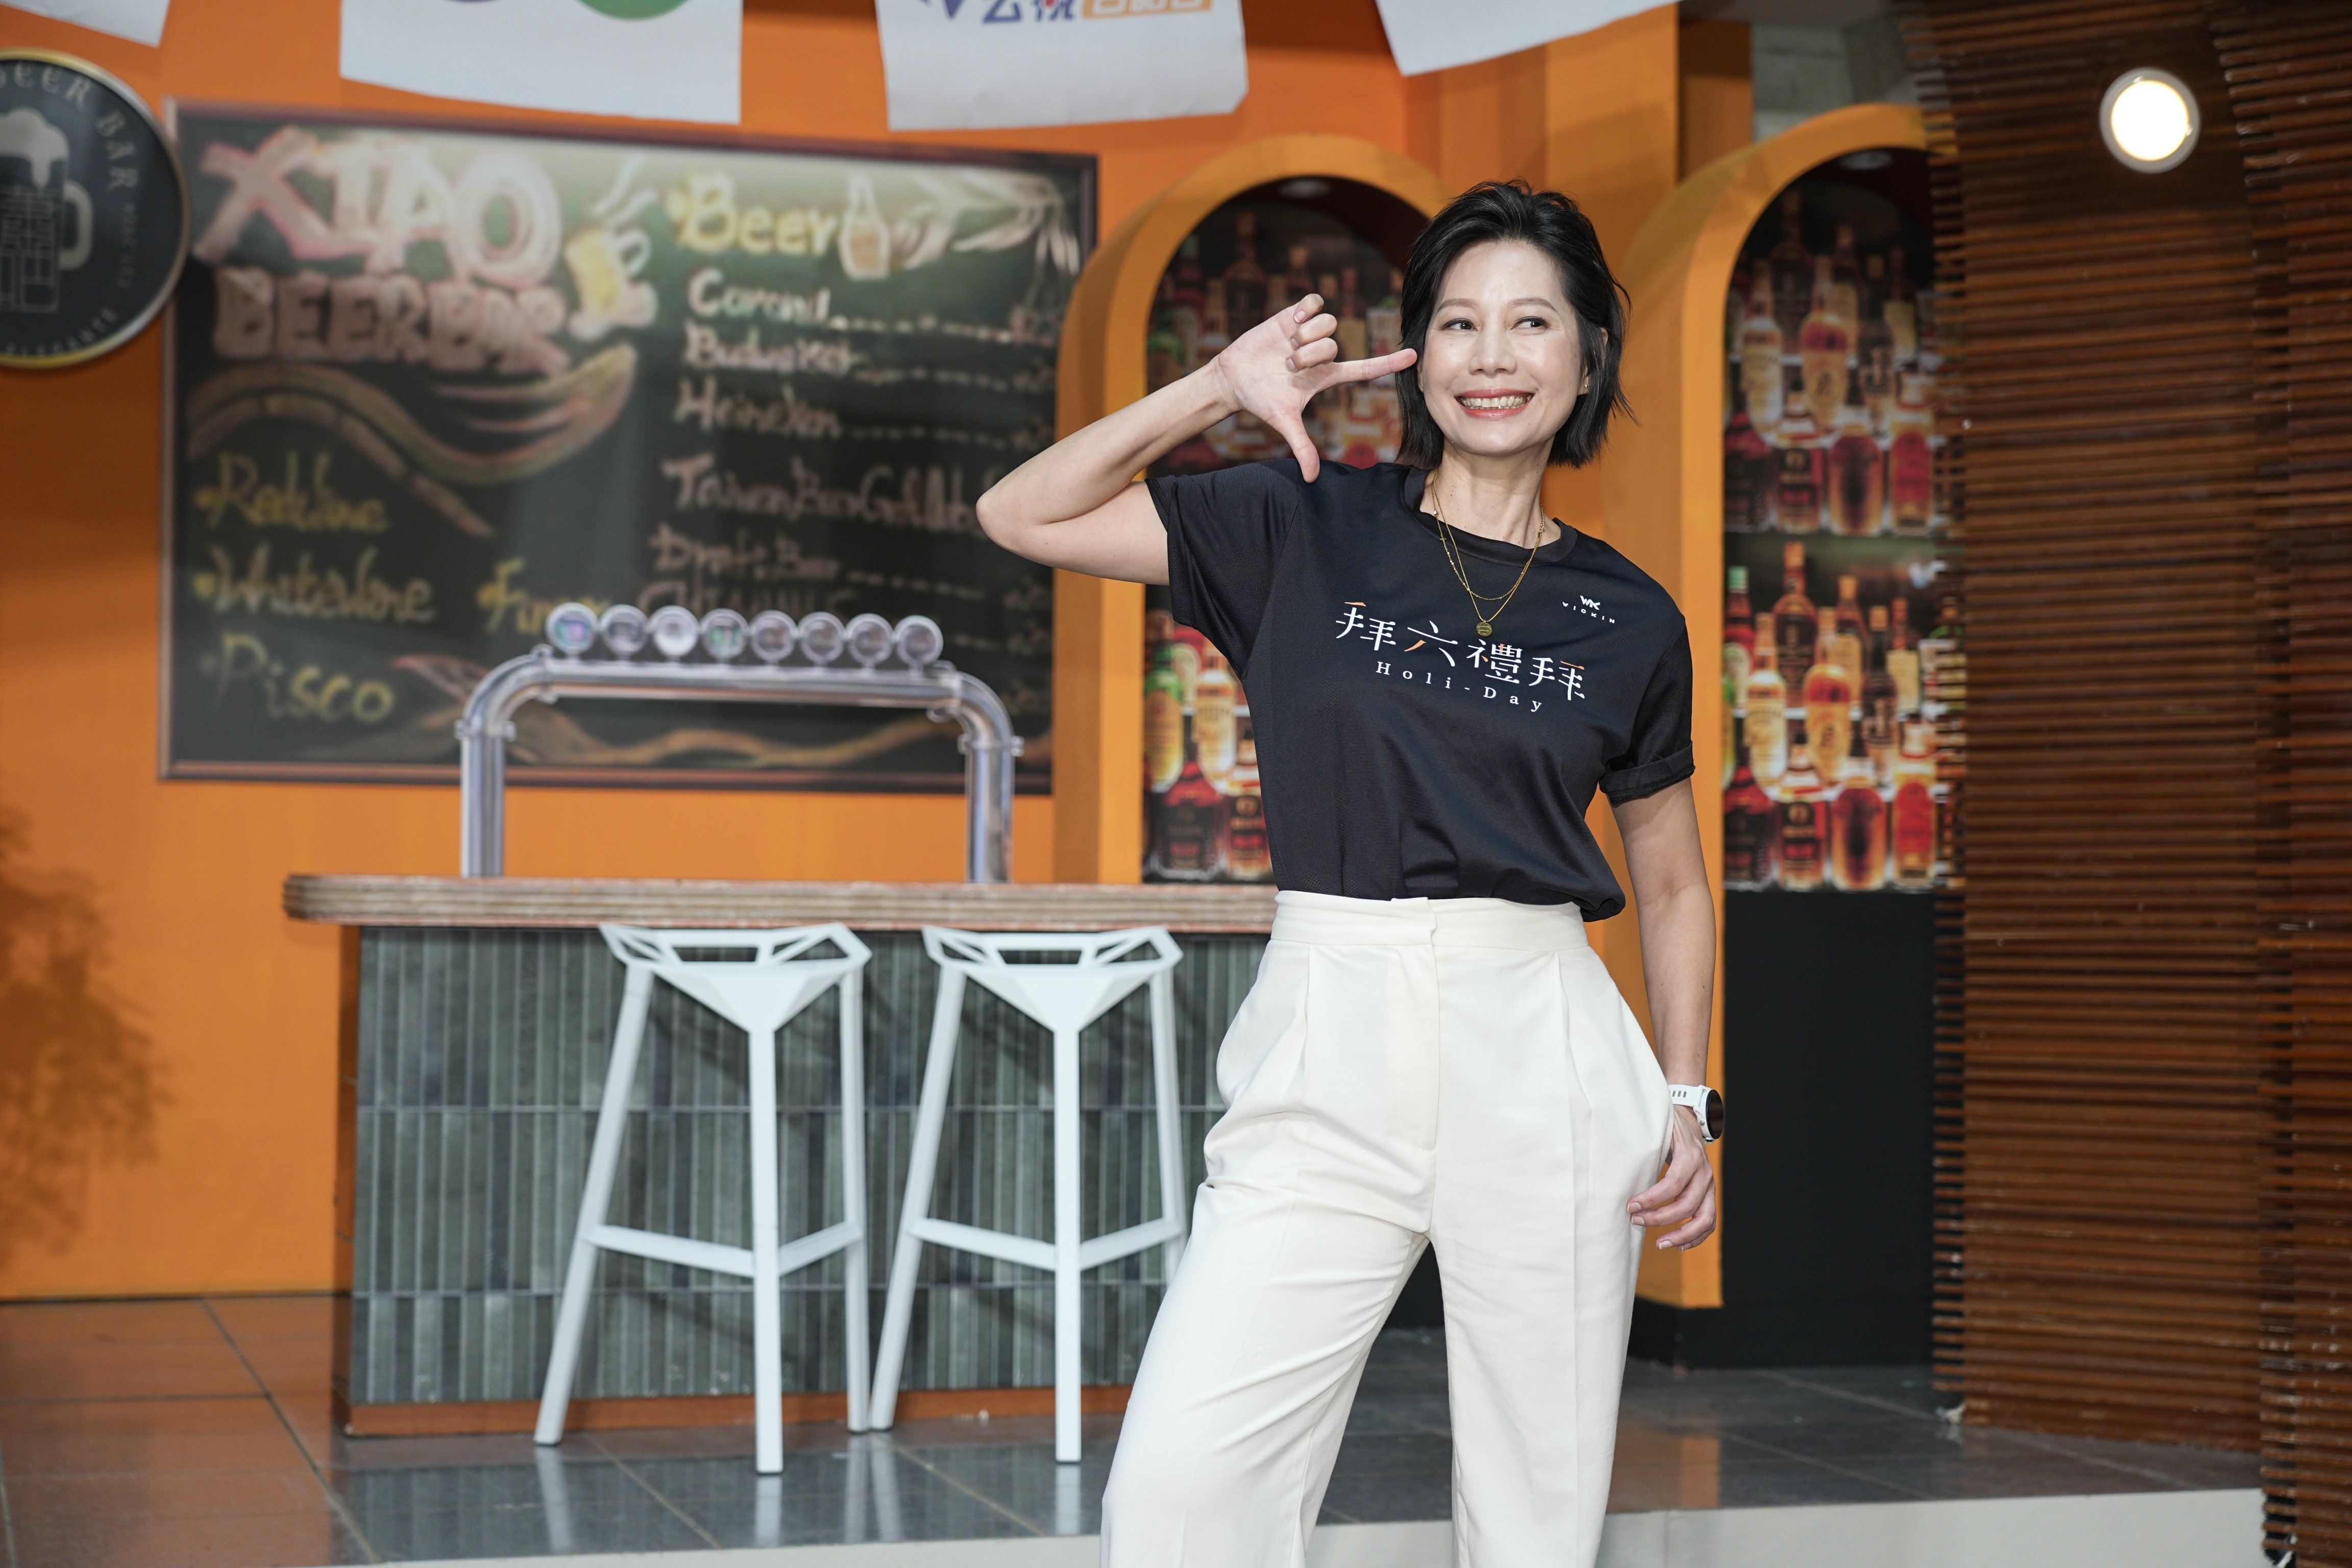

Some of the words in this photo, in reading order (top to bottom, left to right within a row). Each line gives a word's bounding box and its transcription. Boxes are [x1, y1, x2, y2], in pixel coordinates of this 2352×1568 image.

[0, 60, 91, 108] EER
[192, 125, 562, 288] XIAO
[1335, 602, 1585, 701] 拜六禮拜
[1376, 661, 1542, 713] Holi-Day
